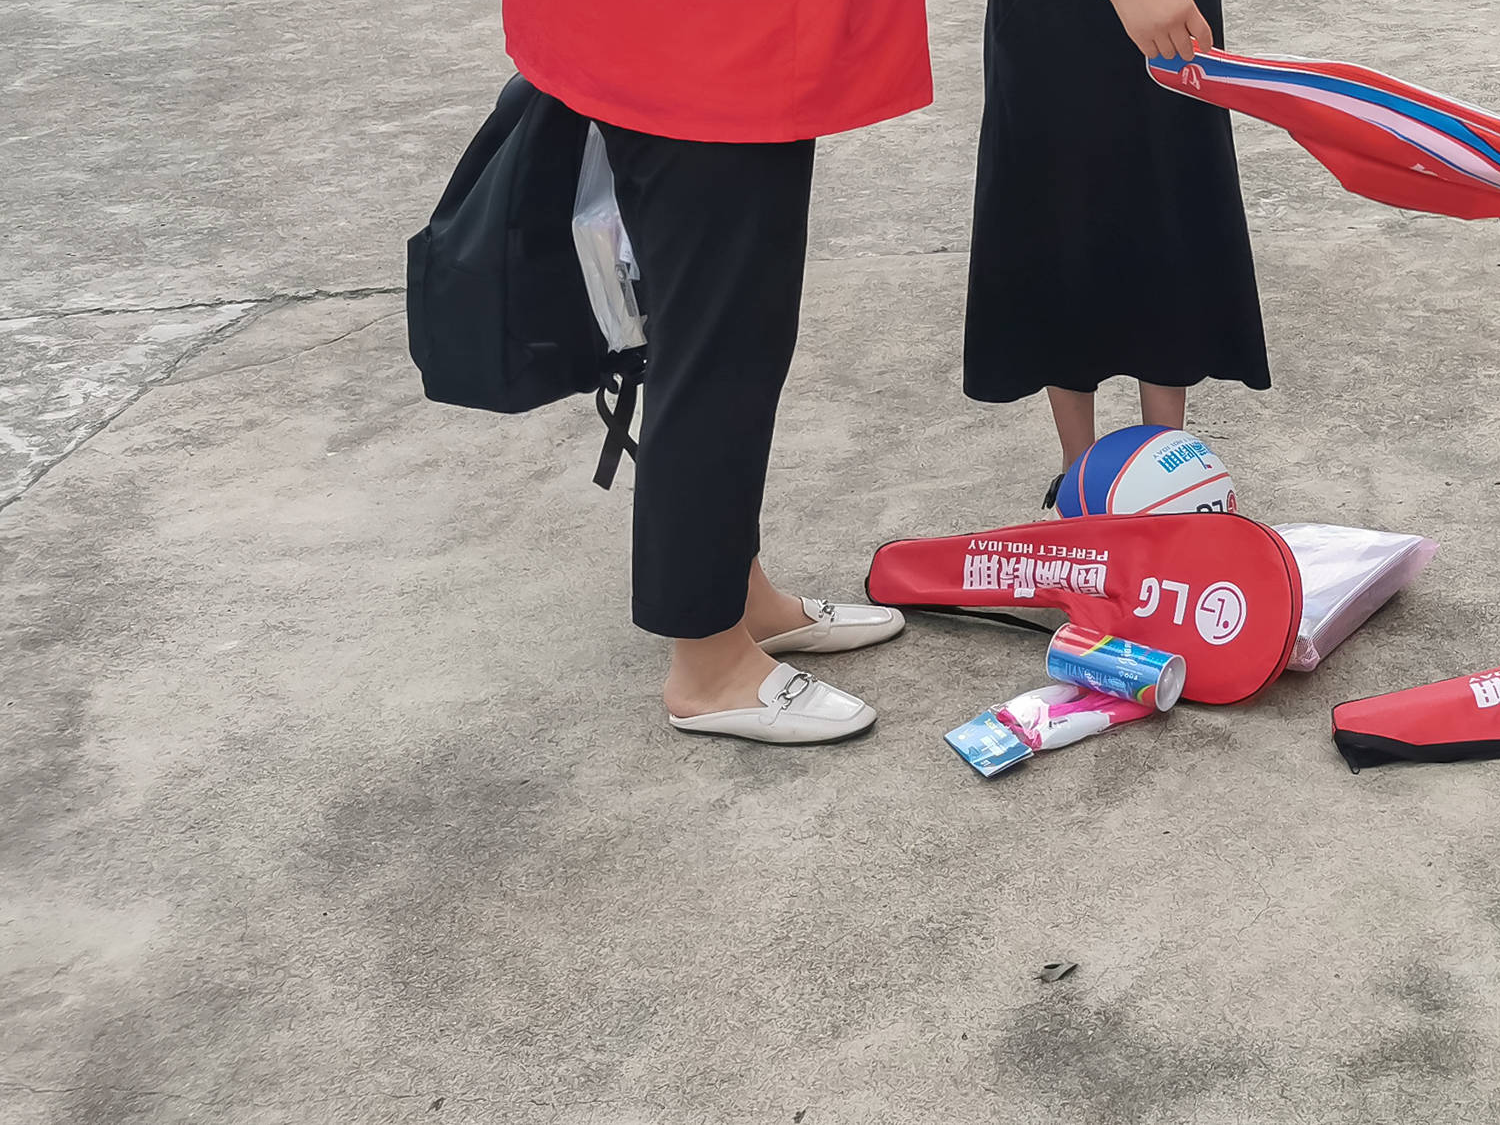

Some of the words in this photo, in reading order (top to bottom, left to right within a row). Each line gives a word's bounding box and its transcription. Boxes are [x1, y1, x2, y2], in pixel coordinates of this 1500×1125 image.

[968, 539, 1034, 555] HOLIDAY
[1037, 544, 1108, 562] PERFECT
[1133, 577, 1189, 625] LG
